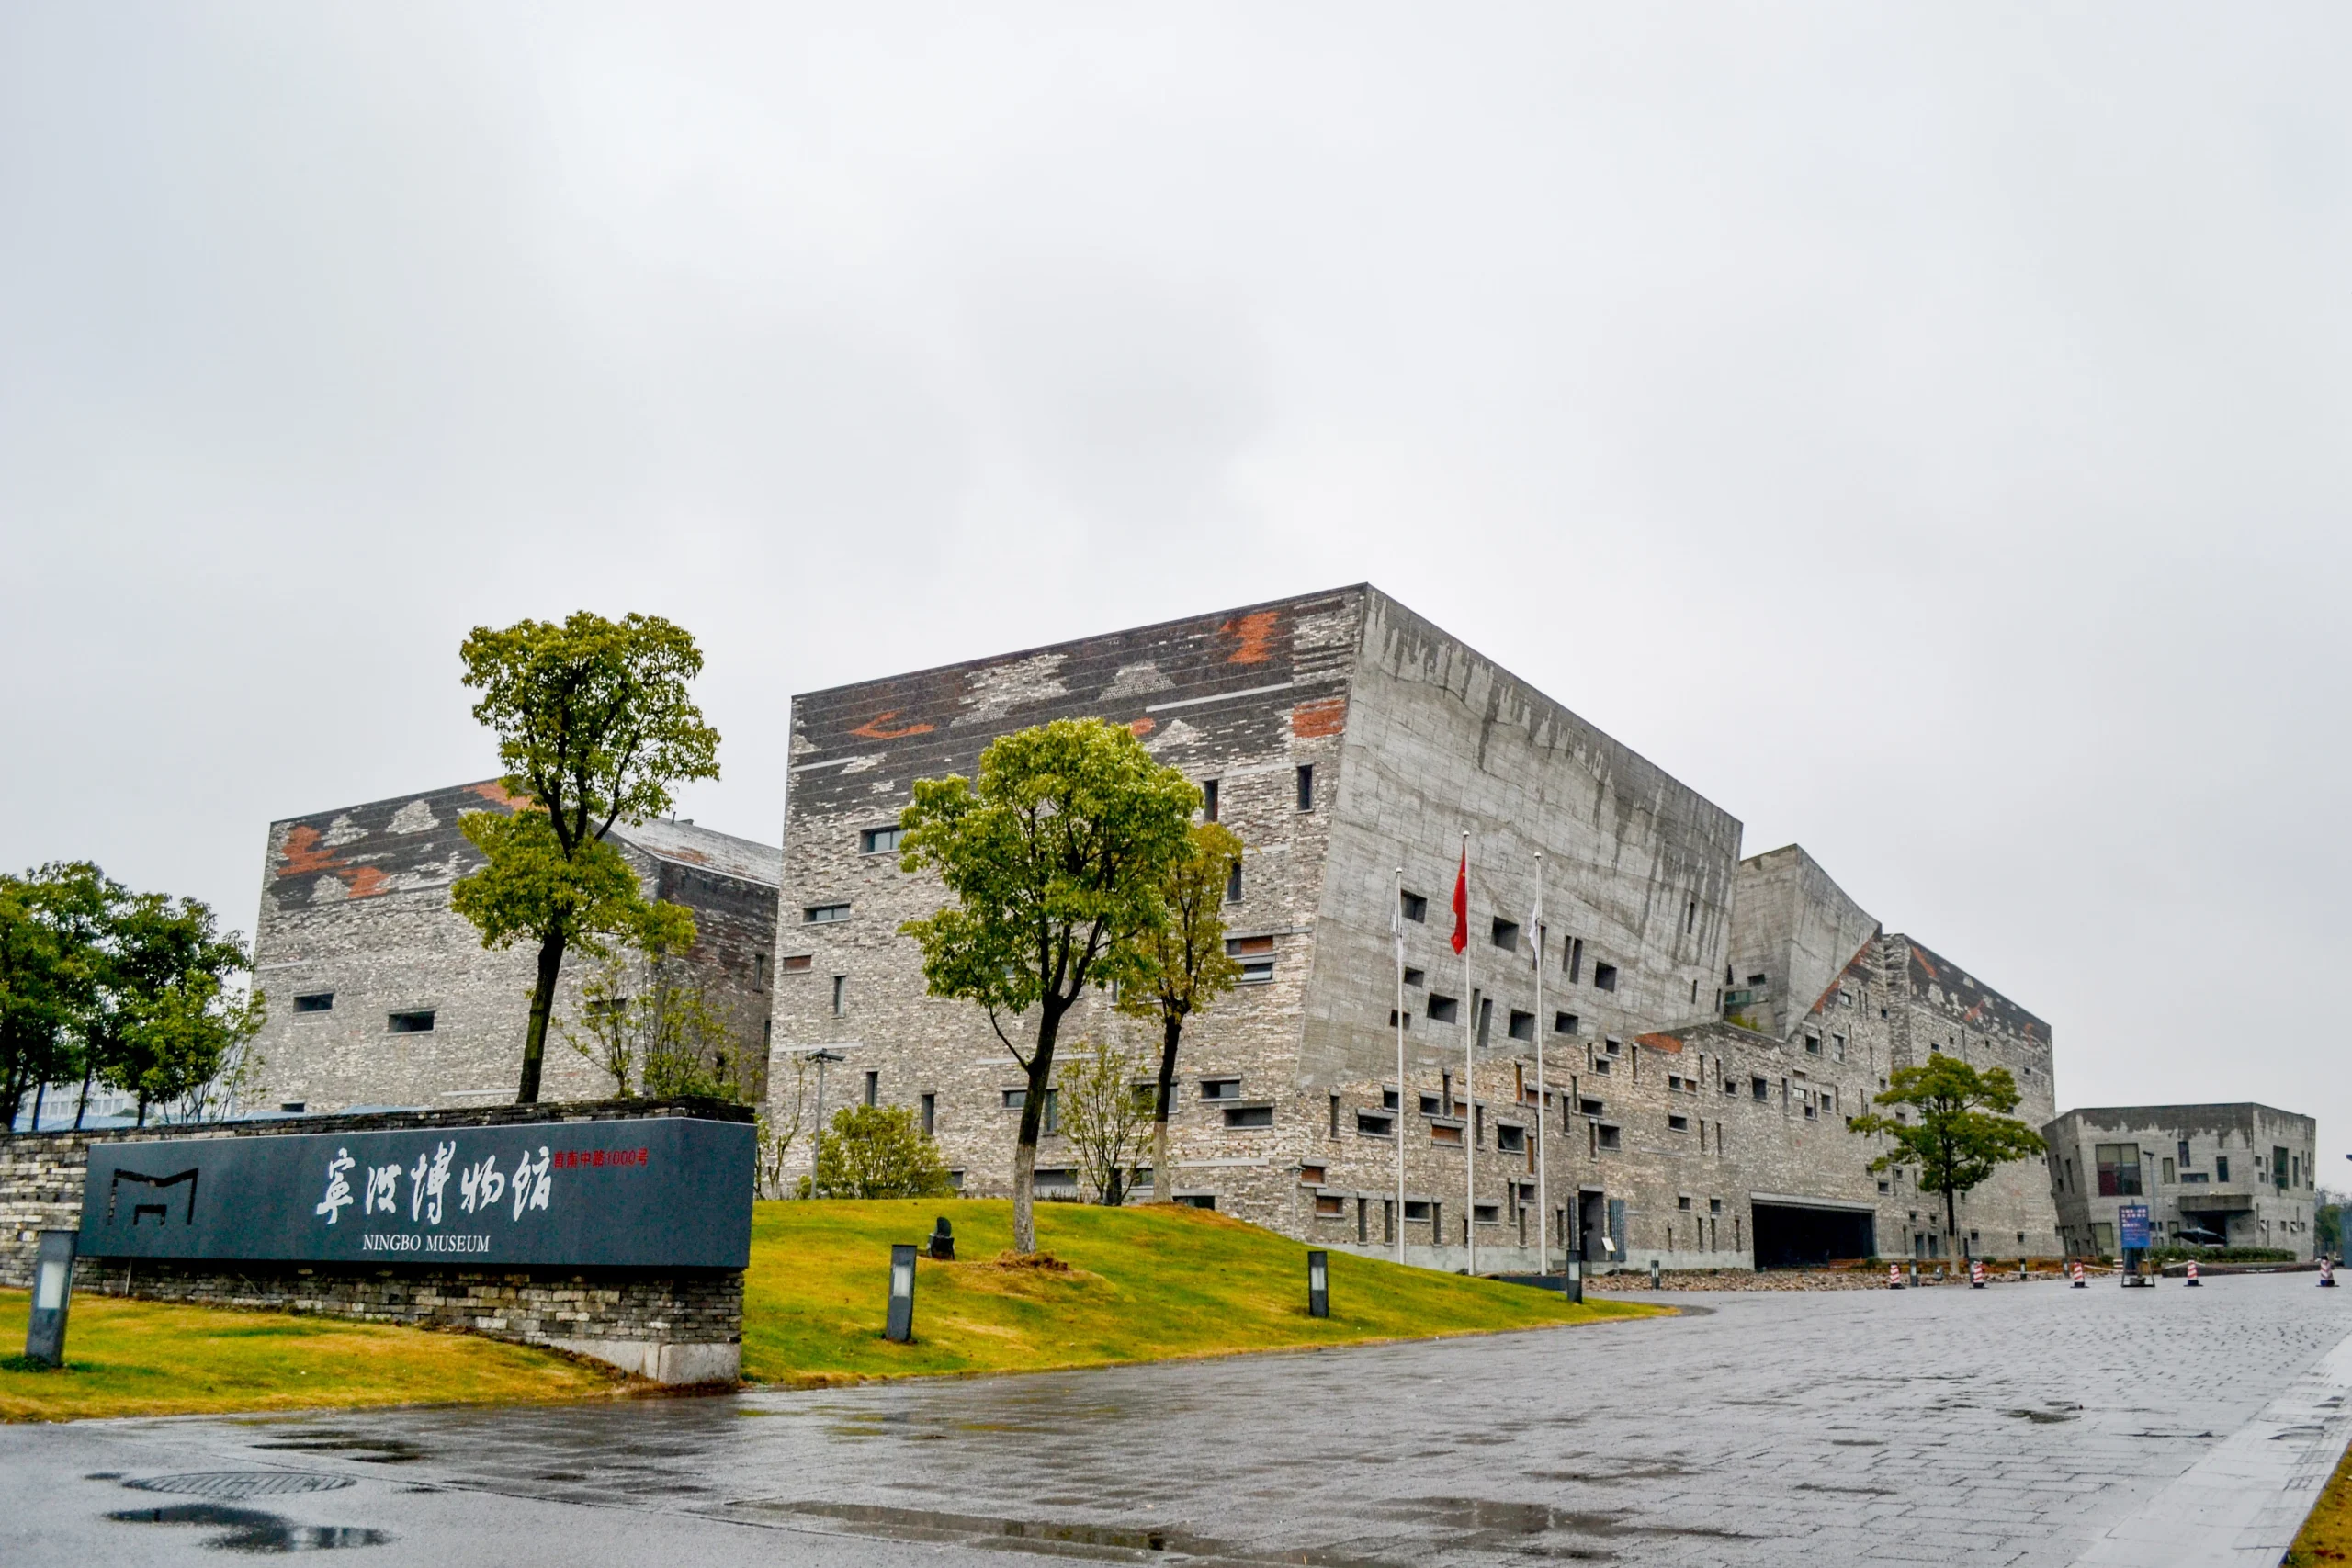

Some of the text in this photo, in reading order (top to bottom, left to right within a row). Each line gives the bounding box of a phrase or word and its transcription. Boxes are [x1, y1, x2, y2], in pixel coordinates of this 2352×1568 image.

[554, 1147, 648, 1168] 首南中路1000号
[362, 1235, 490, 1252] NINGBO MUSEUM
